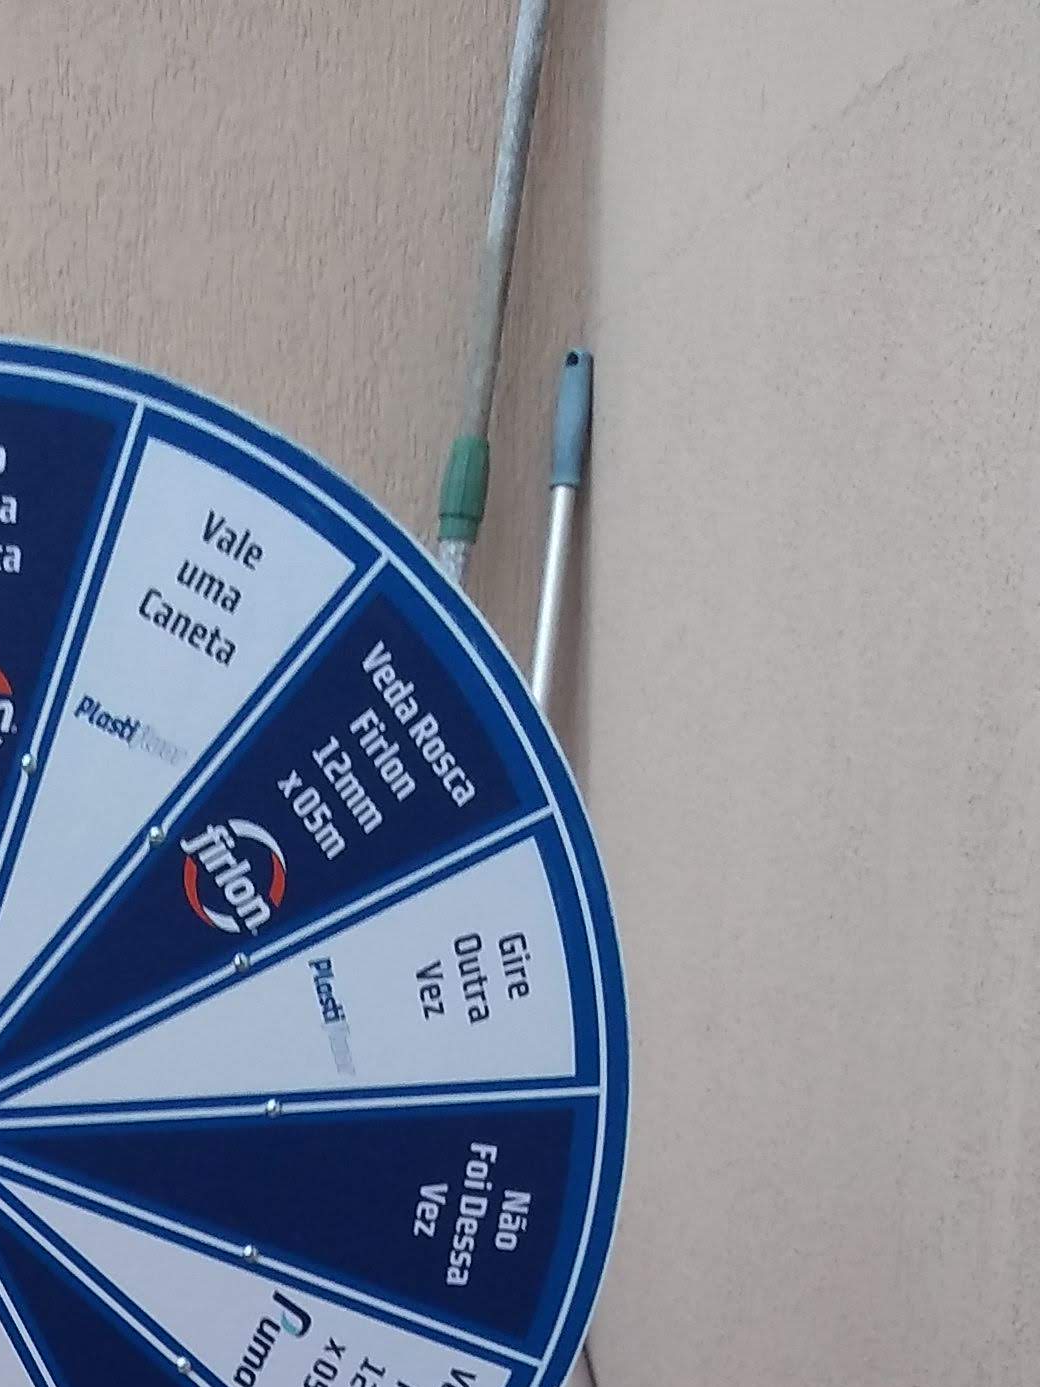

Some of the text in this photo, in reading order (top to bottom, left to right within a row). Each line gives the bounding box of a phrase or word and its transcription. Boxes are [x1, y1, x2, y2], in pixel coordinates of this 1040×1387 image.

[202, 510, 263, 570] Vale
[176, 559, 242, 613] uma
[138, 588, 236, 666] Caneta
[349, 707, 416, 802] Firlon
[362, 640, 476, 808] Veda Rosca
[277, 769, 346, 861] x 05m
[311, 735, 383, 835] 12mm
[415, 959, 445, 1020] Vez
[453, 933, 490, 1025] Outra
[498, 932, 531, 1000] Gire
[413, 1183, 449, 1237] Vez
[446, 1142, 498, 1286] Foi Dessa
[494, 1189, 532, 1251] Não
[324, 1337, 346, 1361] x
